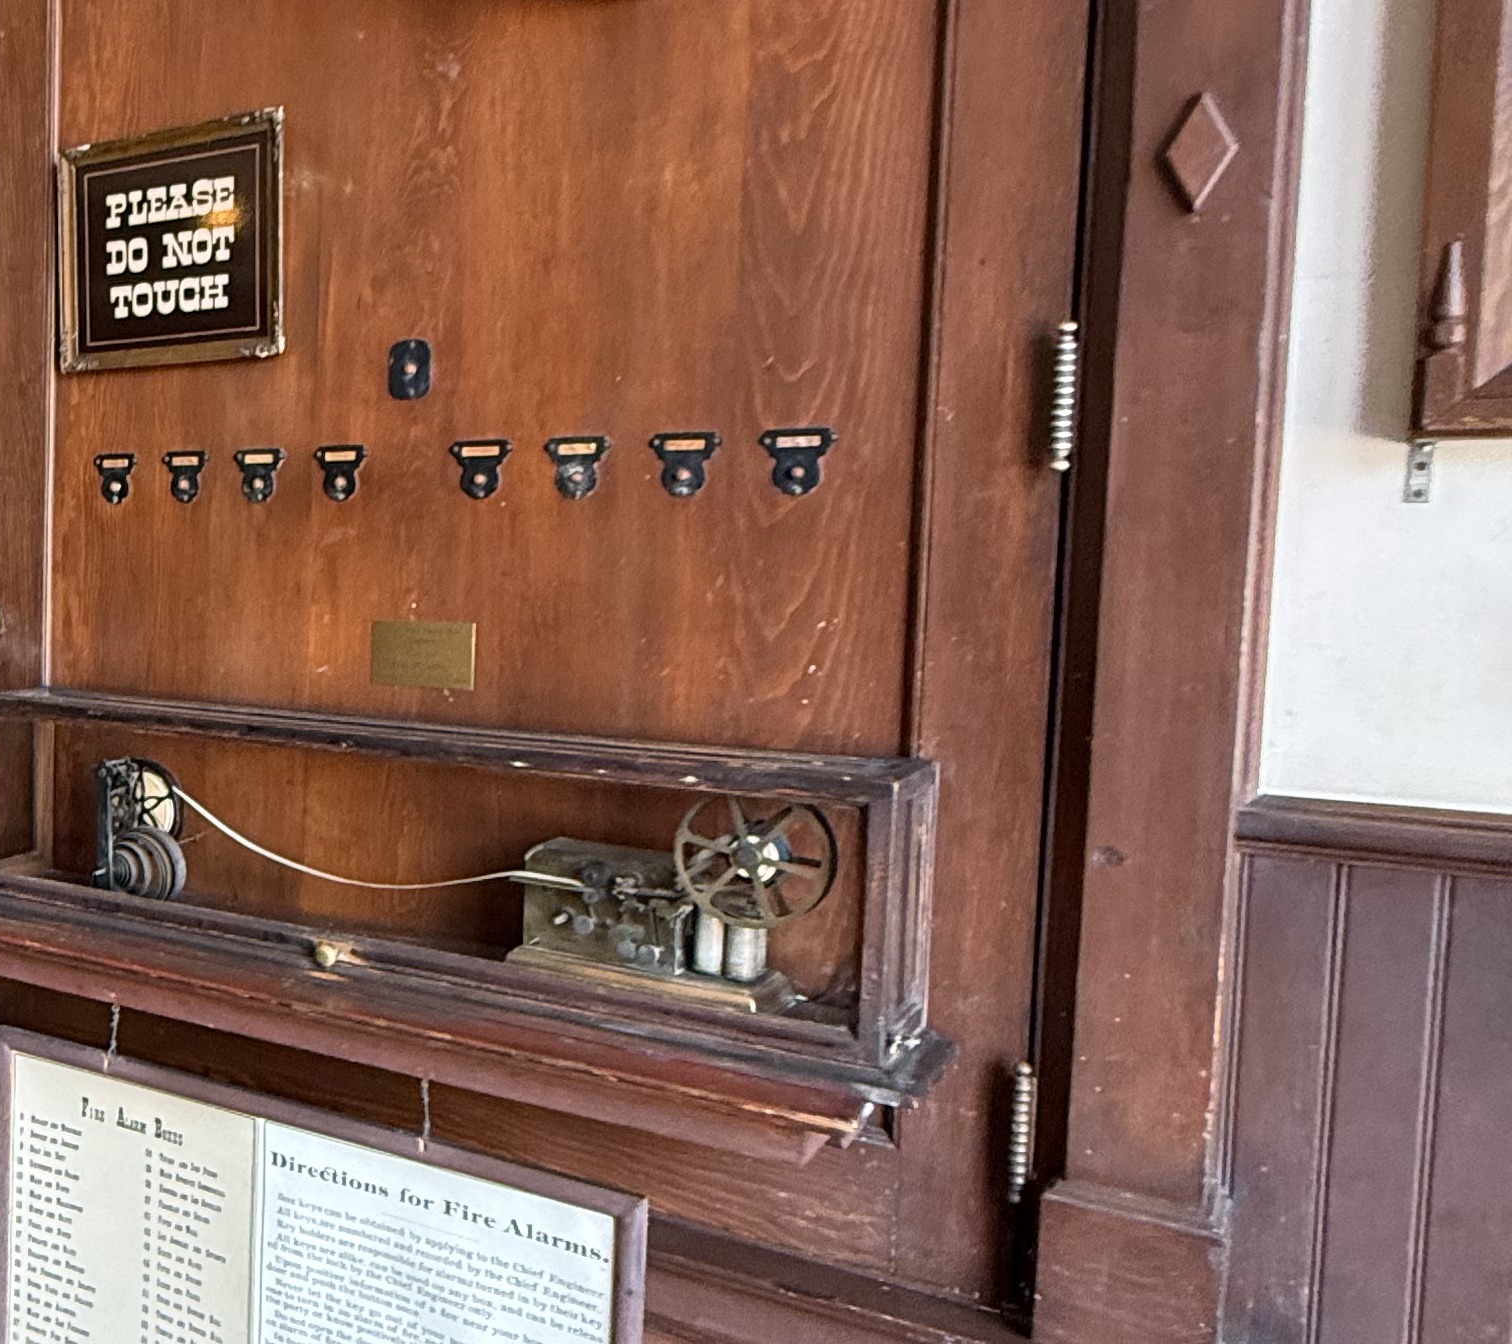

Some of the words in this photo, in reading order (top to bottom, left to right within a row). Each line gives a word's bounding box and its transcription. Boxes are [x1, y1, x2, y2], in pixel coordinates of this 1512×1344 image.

[105, 176, 235, 229] PLEASE
[106, 237, 148, 275] DO
[162, 225, 235, 269] NOT
[110, 274, 229, 319] TOUCH
[270, 1150, 389, 1197] Directions
[399, 1188, 435, 1210] for
[443, 1199, 497, 1229] Fire
[503, 1218, 609, 1264] Alarms.
